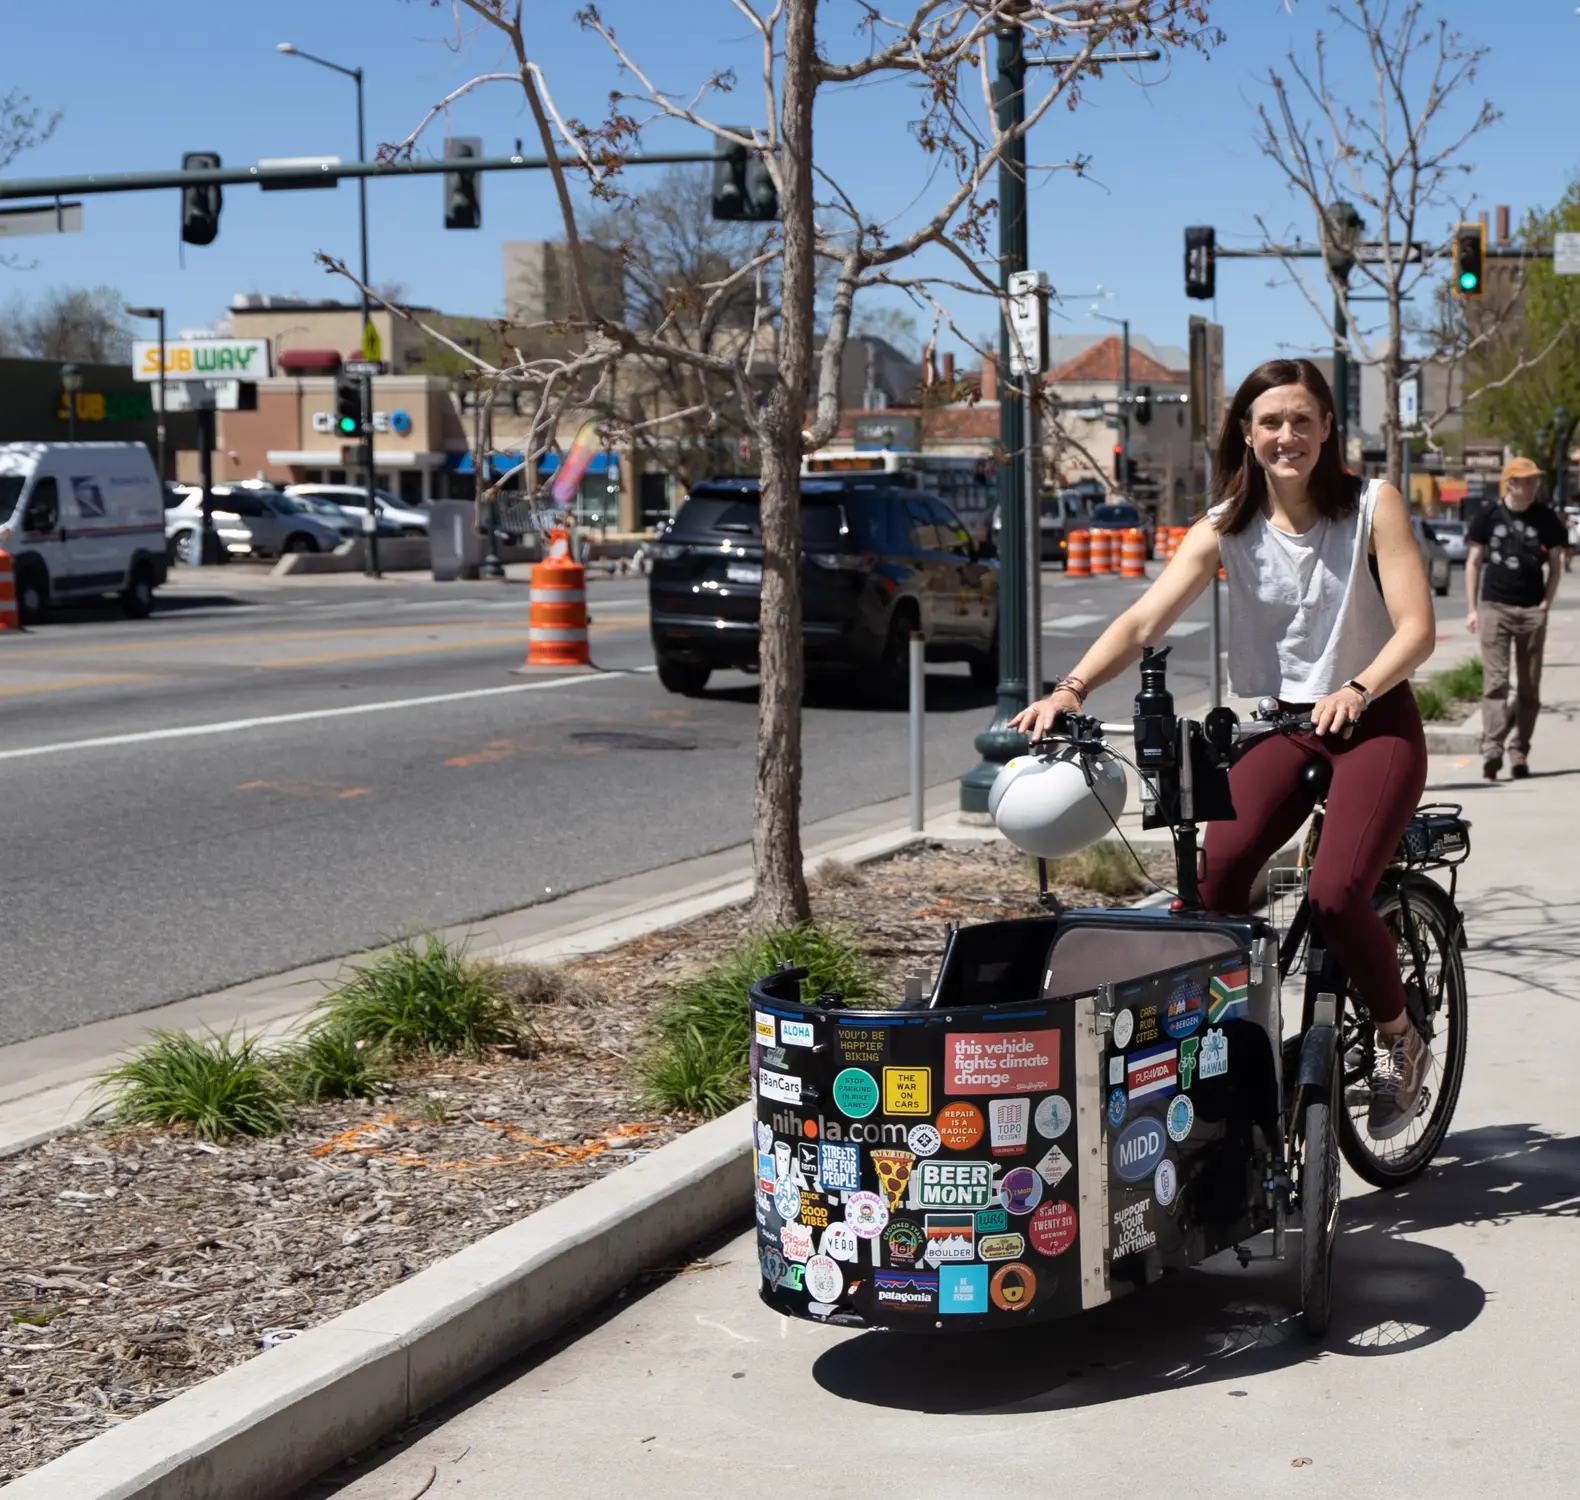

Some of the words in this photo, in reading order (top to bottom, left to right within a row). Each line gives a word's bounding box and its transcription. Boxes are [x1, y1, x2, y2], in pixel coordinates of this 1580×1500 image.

[141, 346, 257, 372] SUBWAY
[1140, 1005, 1157, 1018] CARS
[1139, 1018, 1156, 1030] RUIN
[1175, 1016, 1199, 1030] BERGEN
[783, 1024, 811, 1038] ALOHA
[838, 1030, 868, 1039] YOU'D
[872, 1031, 885, 1040] BE
[1136, 1028, 1159, 1043] CITIES
[840, 1041, 884, 1051] HAPPIER
[954, 1039, 982, 1055] this
[985, 1037, 1034, 1054] vehicle
[845, 1052, 879, 1062] BIKING
[954, 1054, 997, 1074] fights
[999, 1053, 1049, 1069] climate
[1200, 1060, 1227, 1076] HAWAII
[759, 1073, 800, 1093] #BanCars
[898, 1074, 915, 1082] THE
[954, 1070, 1010, 1088] change
[894, 1100, 919, 1109] CARS
[945, 1110, 974, 1118] REPAIR
[773, 1109, 907, 1143] nihola.com
[941, 1127, 978, 1135] RADICAL
[998, 1124, 1022, 1134] TOPO
[822, 1144, 856, 1161] STREETS
[1119, 1131, 1159, 1168] MIDD
[801, 1161, 817, 1172] tern
[822, 1159, 838, 1172] ARE
[840, 1161, 856, 1174] FOR
[823, 1172, 857, 1188] PEOPLE
[924, 1165, 987, 1185] BEER
[800, 1191, 820, 1200] STUCK
[923, 1185, 987, 1204] MONT
[801, 1198, 810, 1206] ON
[800, 1206, 828, 1218] GOOD
[1113, 1198, 1150, 1224] SUPPORT
[801, 1215, 828, 1228] VIBES
[1034, 1218, 1060, 1232] TWENTY
[1062, 1216, 1073, 1227] SIX
[1121, 1214, 1144, 1232] YOUR
[883, 1222, 910, 1240] CROOKED
[911, 1226, 924, 1244] STAVE
[1119, 1224, 1148, 1245] LOCAL
[828, 1238, 854, 1252] VERO
[1112, 1231, 1156, 1260] ANYTHING
[928, 1248, 972, 1258] BOULDER
[954, 1285, 959, 1293] A
[960, 1278, 967, 1286] BE
[878, 1291, 932, 1303] patagonia
